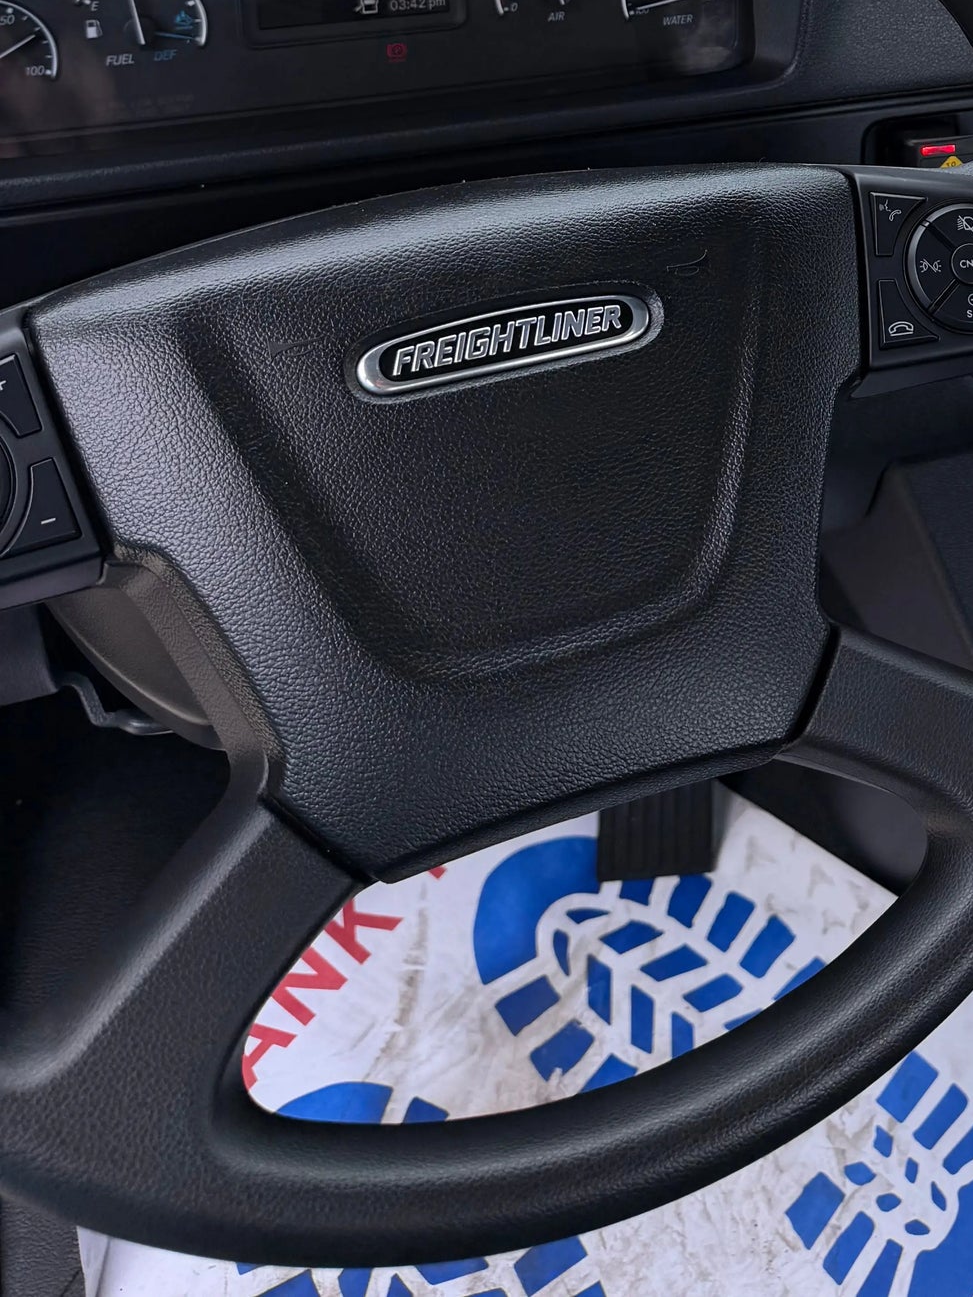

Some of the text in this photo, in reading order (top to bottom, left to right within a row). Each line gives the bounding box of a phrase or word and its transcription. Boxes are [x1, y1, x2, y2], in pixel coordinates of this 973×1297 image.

[428, 0, 446, 10] pm
[548, 11, 565, 21] AIR
[663, 14, 693, 26] WATER
[106, 54, 135, 66] FUEL
[154, 49, 177, 61] DEF
[25, 65, 45, 76] 100
[392, 305, 622, 376] FREIGHTLINER
[242, 898, 404, 1090] ANK
